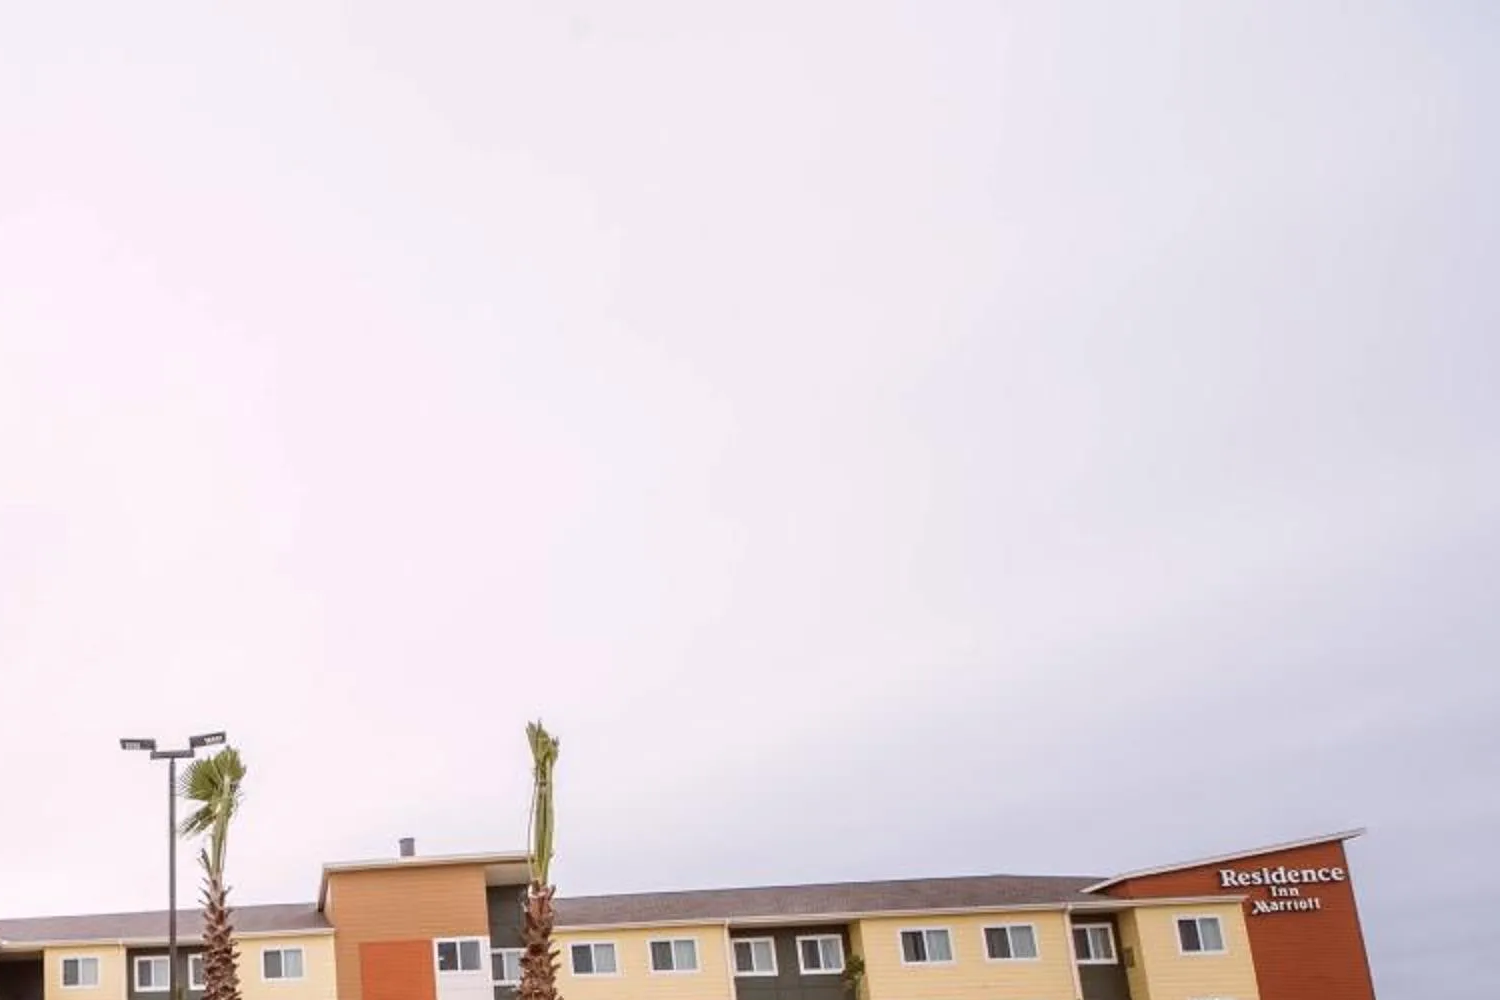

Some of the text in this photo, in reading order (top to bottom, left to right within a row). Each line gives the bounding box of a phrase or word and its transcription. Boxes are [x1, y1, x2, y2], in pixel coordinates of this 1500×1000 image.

[1219, 866, 1345, 887] Residence
[1269, 885, 1300, 898] Inn
[1251, 897, 1321, 915] Marriott
